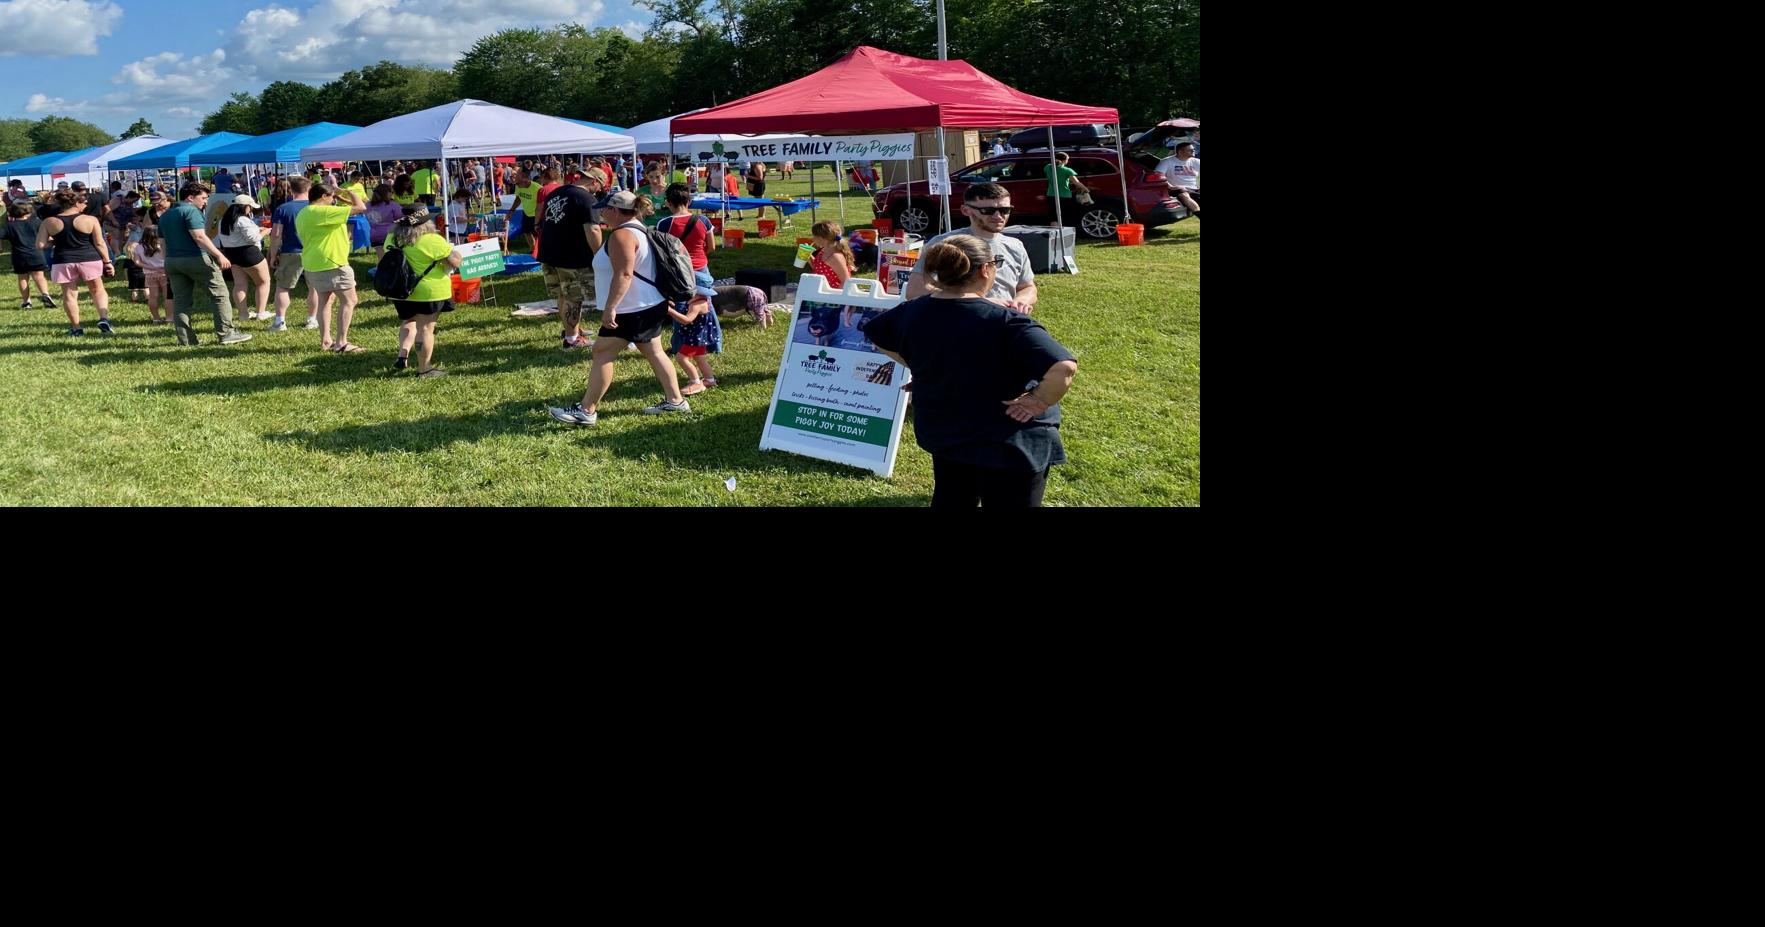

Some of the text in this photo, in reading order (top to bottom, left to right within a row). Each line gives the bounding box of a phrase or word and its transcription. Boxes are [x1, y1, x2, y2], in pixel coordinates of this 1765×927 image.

[741, 139, 913, 157] TREE FAMILY Party Piggies
[800, 360, 841, 373] TREE FAMILY
[797, 406, 869, 425] STOP IN FOR SOME
[795, 416, 867, 437] PIGGY JOY TODAY!
